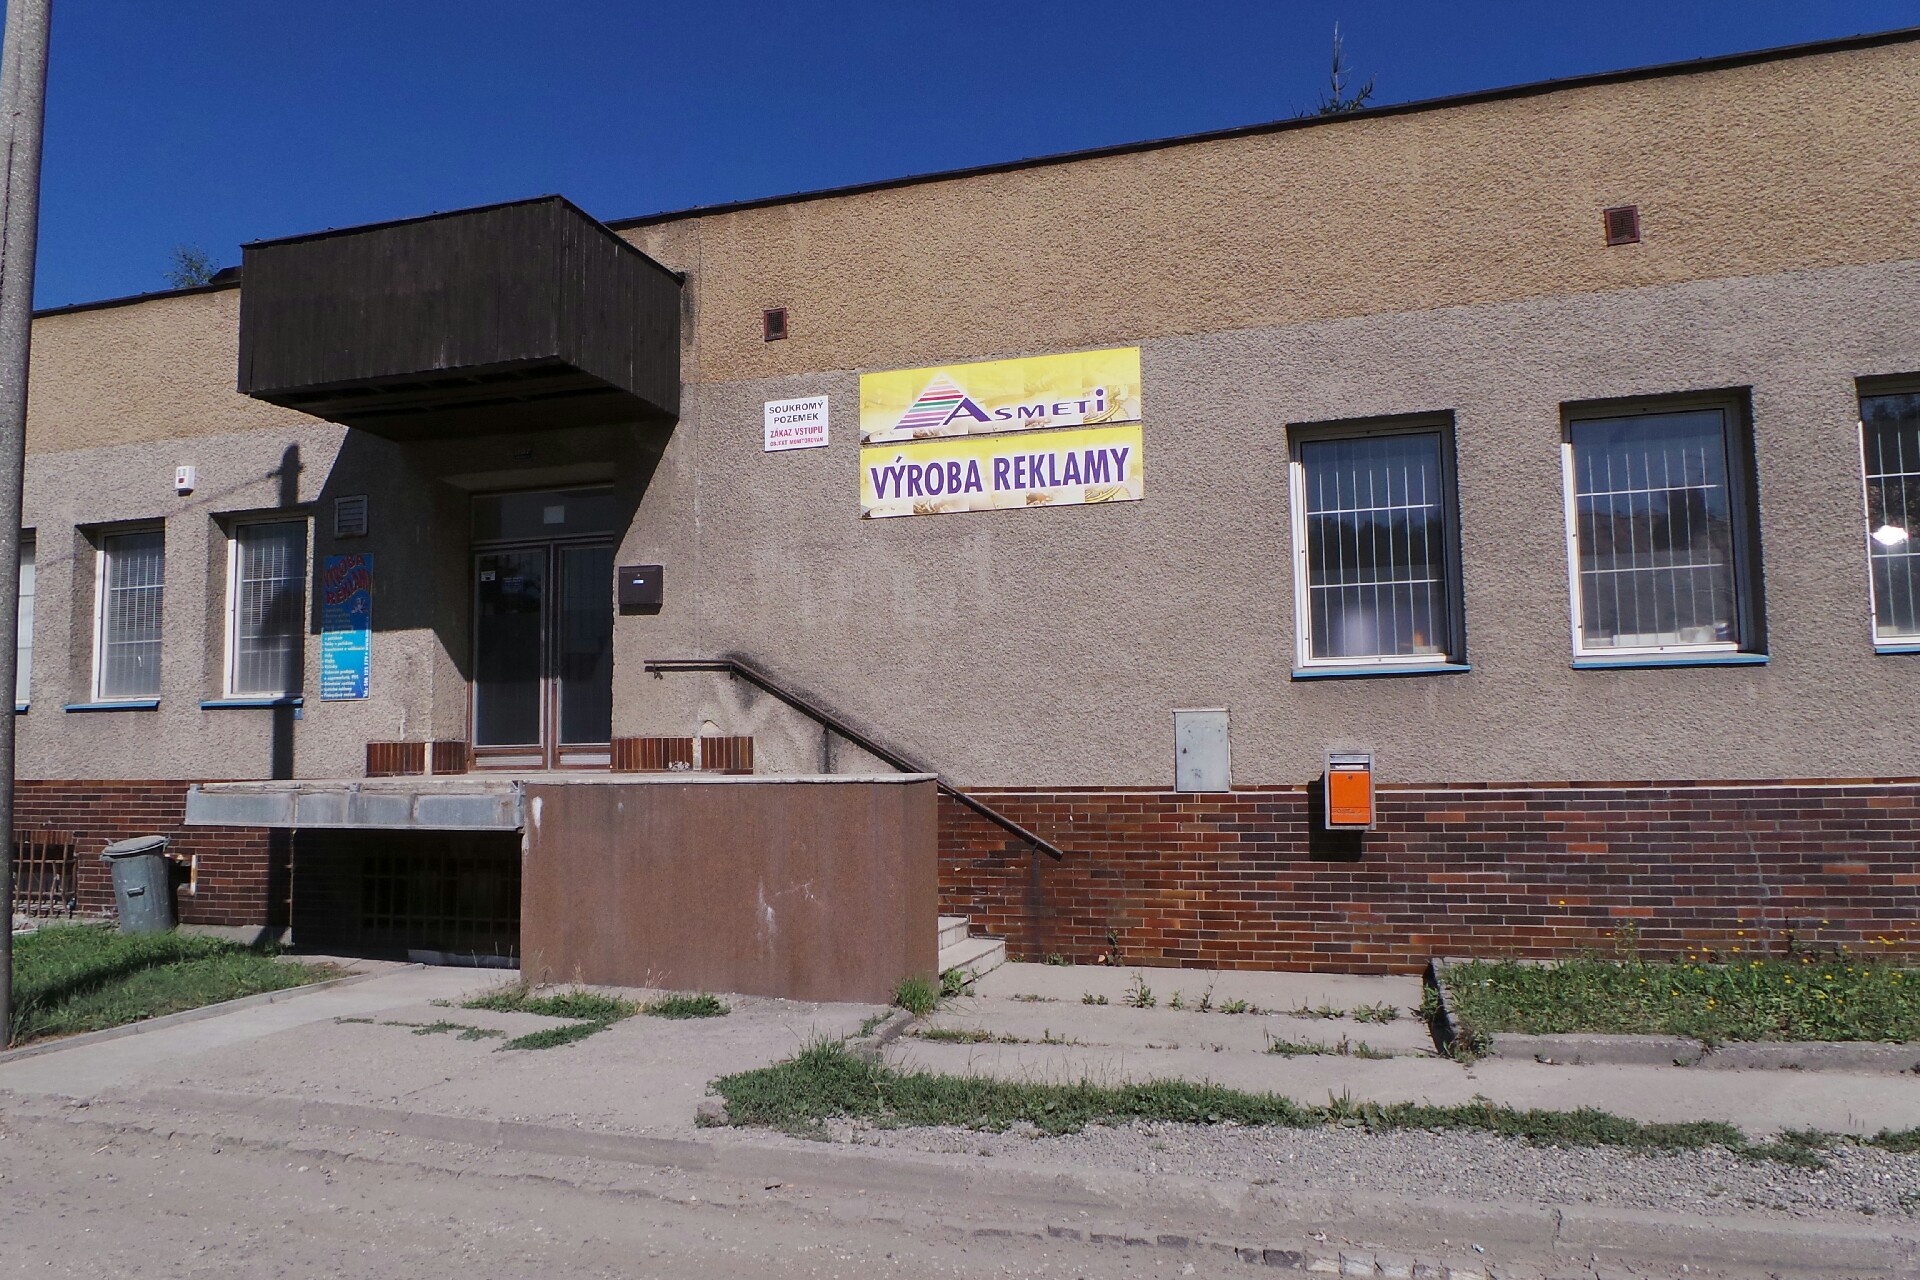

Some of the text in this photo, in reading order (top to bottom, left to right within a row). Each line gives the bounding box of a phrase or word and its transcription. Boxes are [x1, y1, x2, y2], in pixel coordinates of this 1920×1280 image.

[769, 400, 824, 414] SOUKROMÝ
[774, 413, 819, 424] POZEMEK
[770, 426, 823, 438] ZÁKAZ VSTUPU
[870, 447, 1130, 499] VÝROBA REKLAMY
